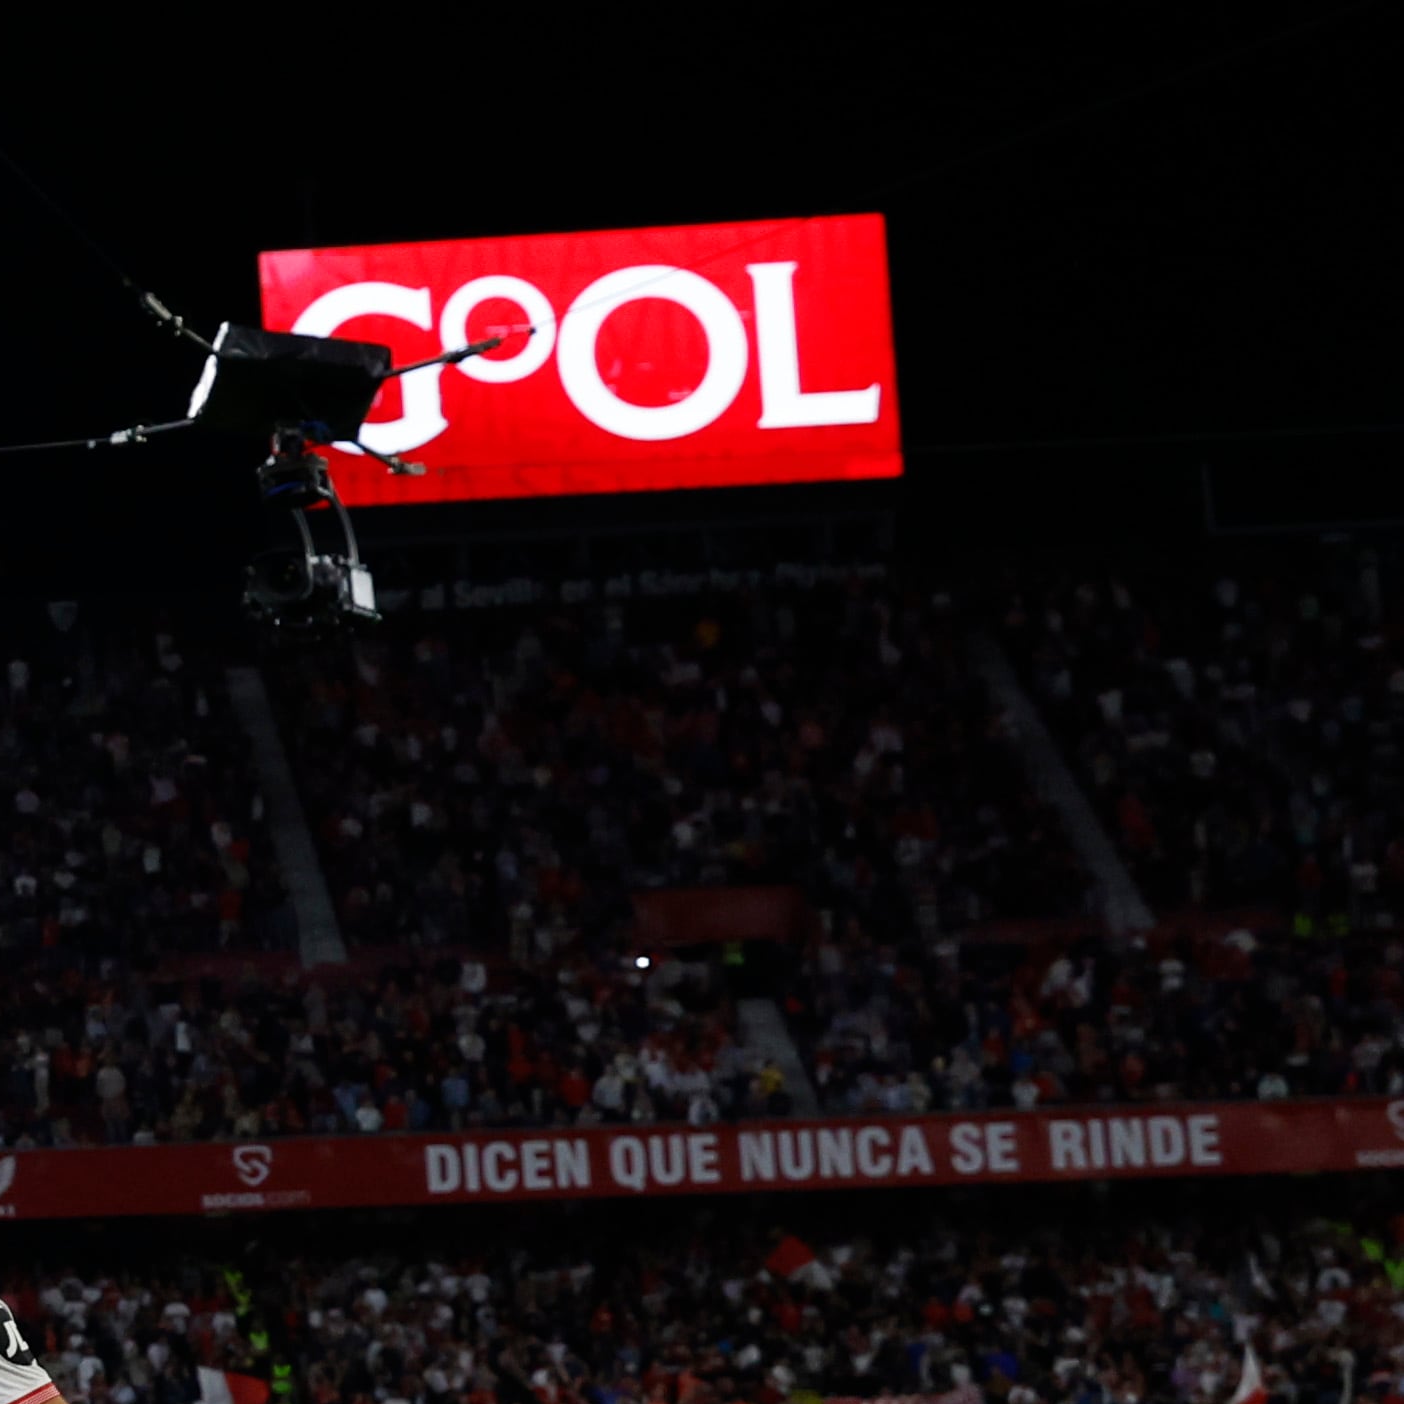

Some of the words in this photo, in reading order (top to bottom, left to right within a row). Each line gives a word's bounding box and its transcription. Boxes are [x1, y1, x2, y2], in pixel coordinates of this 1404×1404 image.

[425, 1139, 591, 1193] DICEN
[609, 1134, 721, 1191] QUE
[738, 1125, 933, 1181] NUNCA
[949, 1122, 1020, 1173] SE
[1048, 1114, 1222, 1172] RINDE
